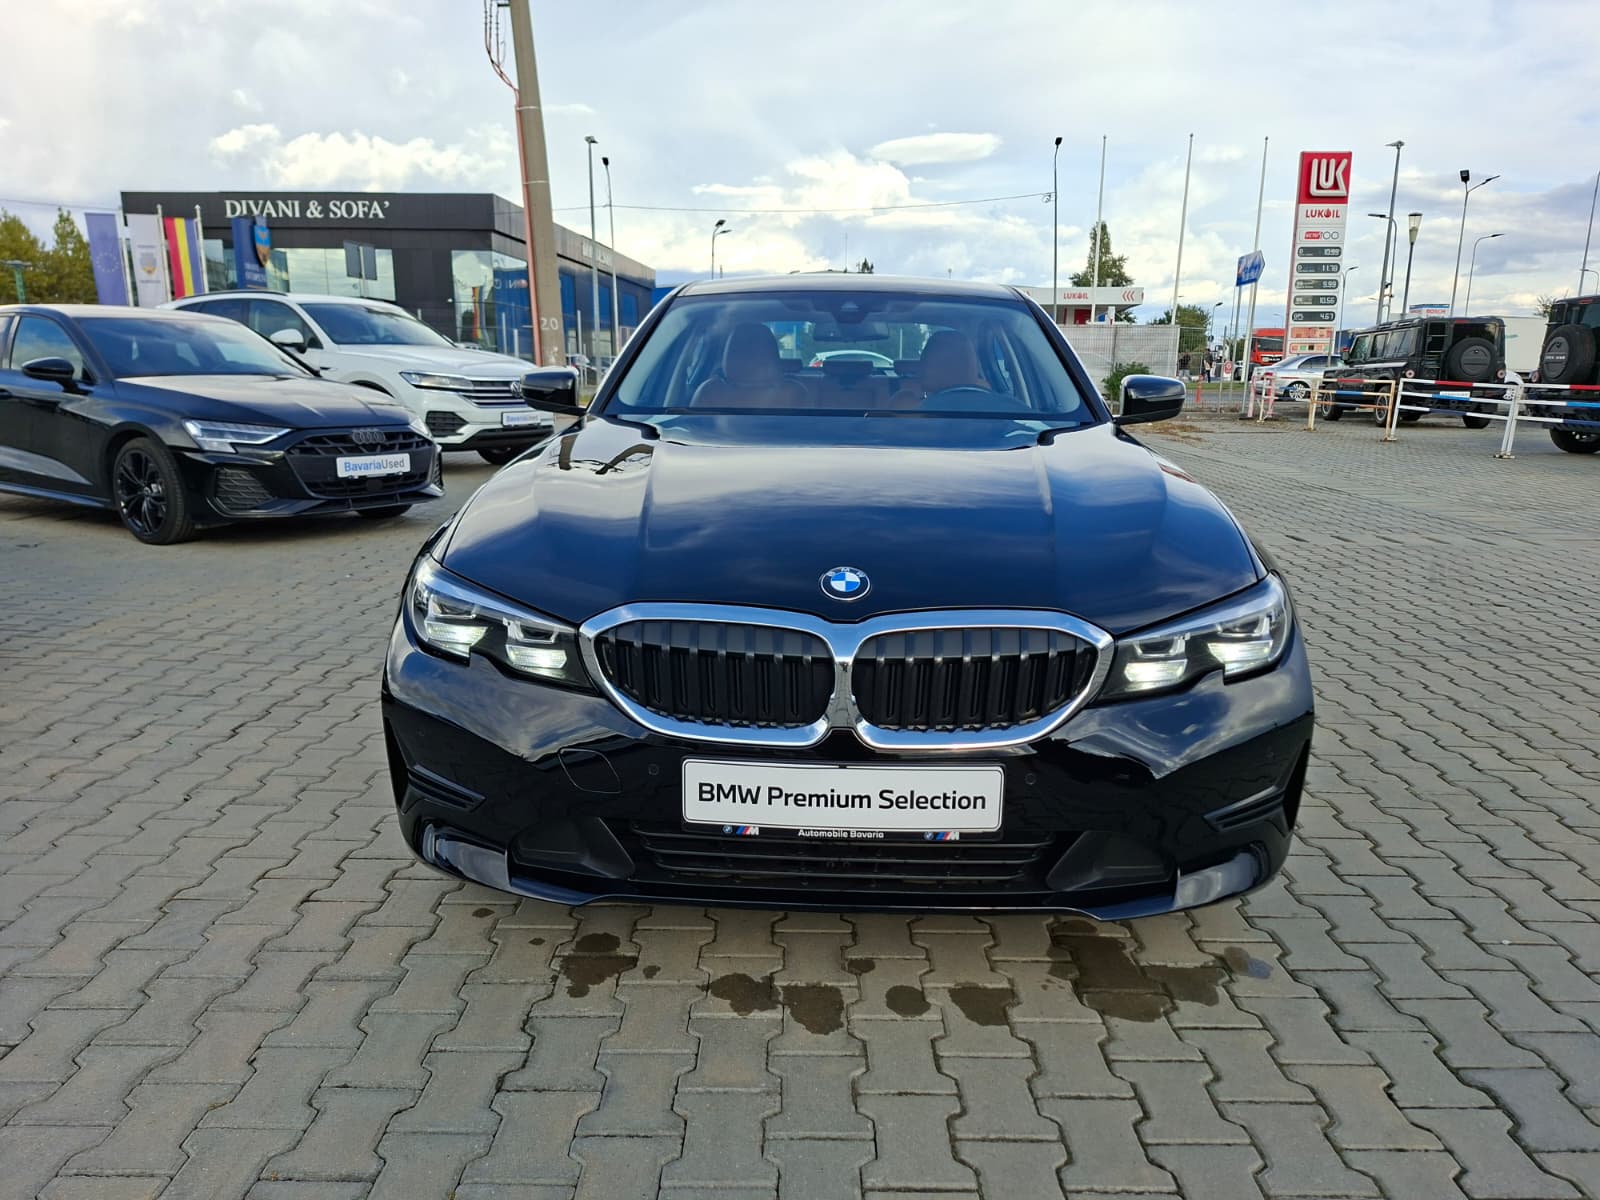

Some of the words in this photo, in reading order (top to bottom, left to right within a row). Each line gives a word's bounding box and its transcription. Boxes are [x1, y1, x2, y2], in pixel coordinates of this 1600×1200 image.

[225, 200, 301, 218] DIVANI
[306, 200, 324, 218] &
[1305, 208, 1341, 218] LUKOIL
[540, 317, 559, 331] 20
[343, 459, 405, 473] BavariaUsed
[698, 782, 761, 805] BMW
[767, 786, 872, 809] Premium
[878, 789, 987, 810] Selection
[798, 829, 848, 839] Automobile
[850, 830, 885, 839] Bavaria
